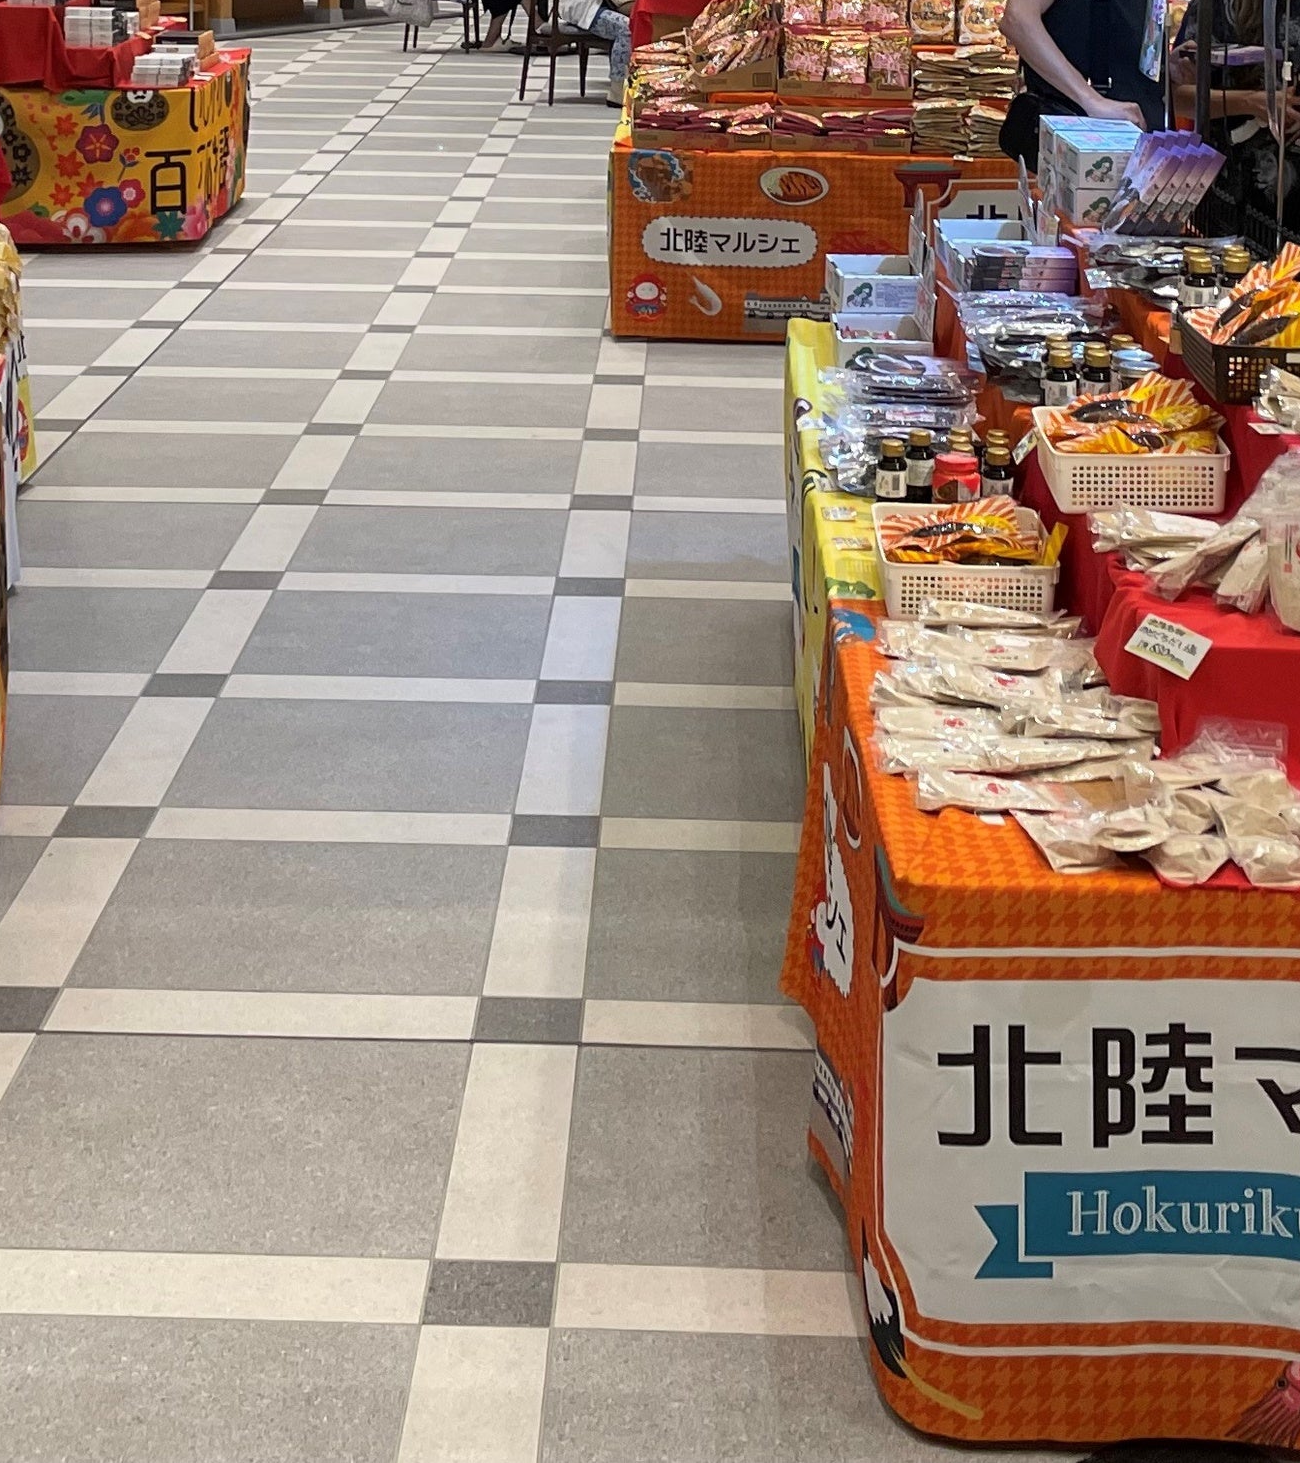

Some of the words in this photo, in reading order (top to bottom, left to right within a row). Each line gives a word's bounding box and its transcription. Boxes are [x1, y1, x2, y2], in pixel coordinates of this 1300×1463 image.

[660, 228, 801, 254] 北陸マルシェ
